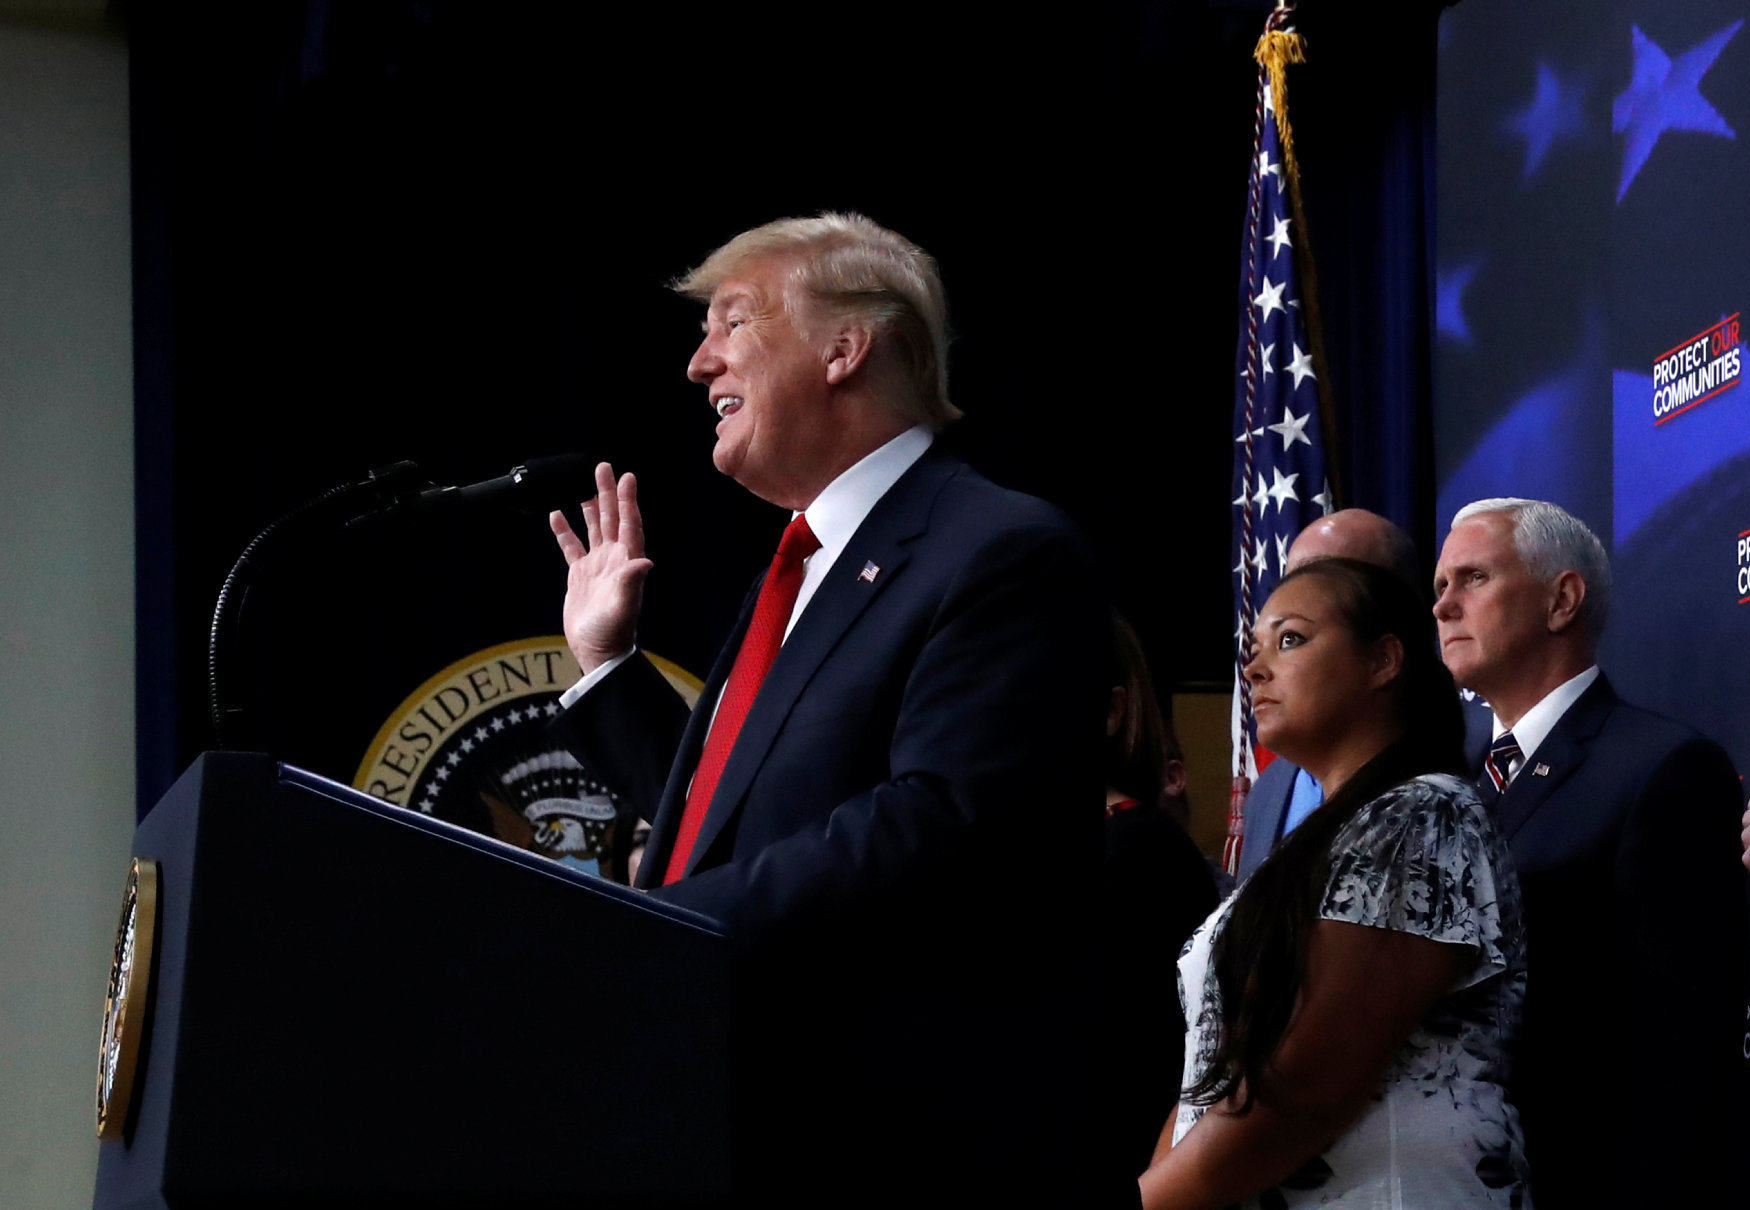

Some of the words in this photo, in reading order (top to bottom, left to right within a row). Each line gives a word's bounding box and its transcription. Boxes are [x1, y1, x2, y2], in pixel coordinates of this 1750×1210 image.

[1653, 337, 1709, 389] PROTECT
[1711, 321, 1740, 355] OUR
[1653, 348, 1741, 417] COMMUNITIES
[368, 650, 563, 801] RESIDENT
